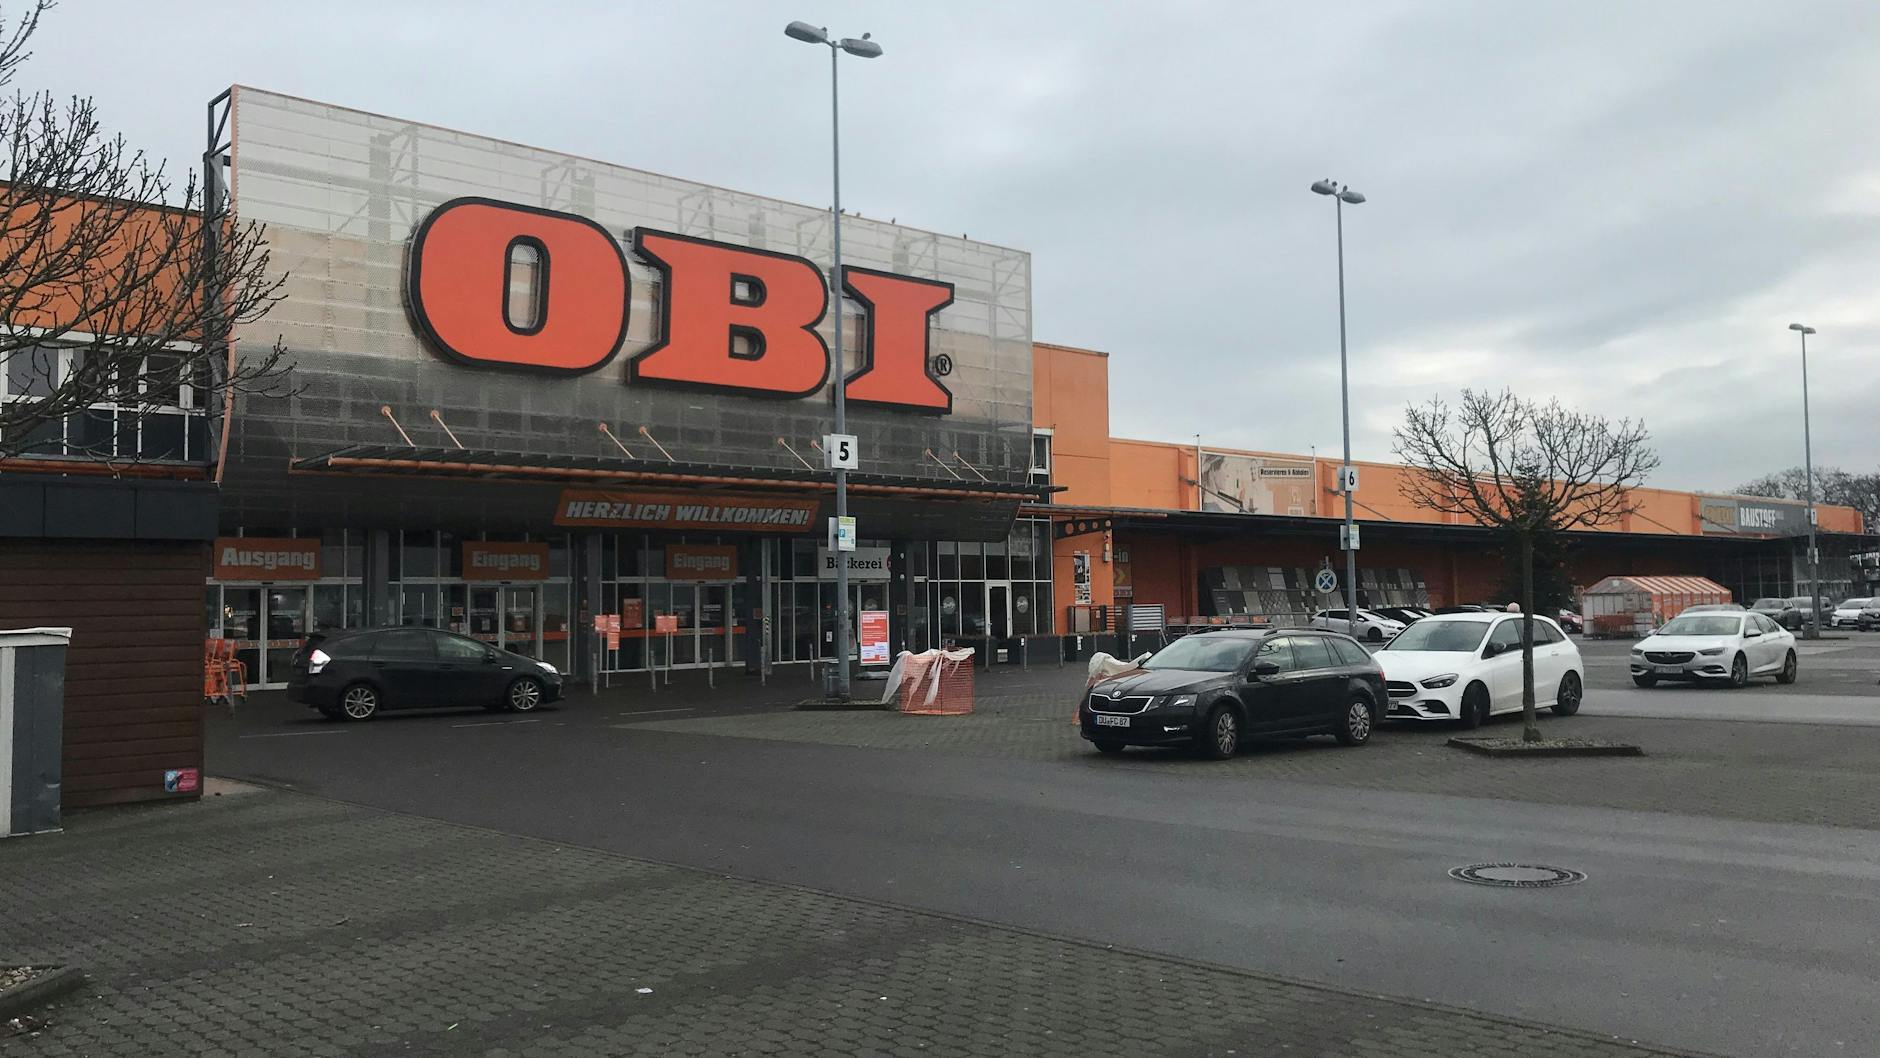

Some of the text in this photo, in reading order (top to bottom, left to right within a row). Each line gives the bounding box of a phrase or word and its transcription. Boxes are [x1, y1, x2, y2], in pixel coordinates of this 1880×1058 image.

[405, 196, 955, 415] OBI
[839, 441, 849, 461] 5
[1349, 471, 1355, 486] 6
[566, 501, 810, 526] HERZLICH WILLKOMMEN!
[1740, 507, 1776, 528] BAUSTOFF
[220, 547, 316, 570] Ausgang
[472, 550, 540, 571] Eingang
[673, 552, 730, 571] Eingang
